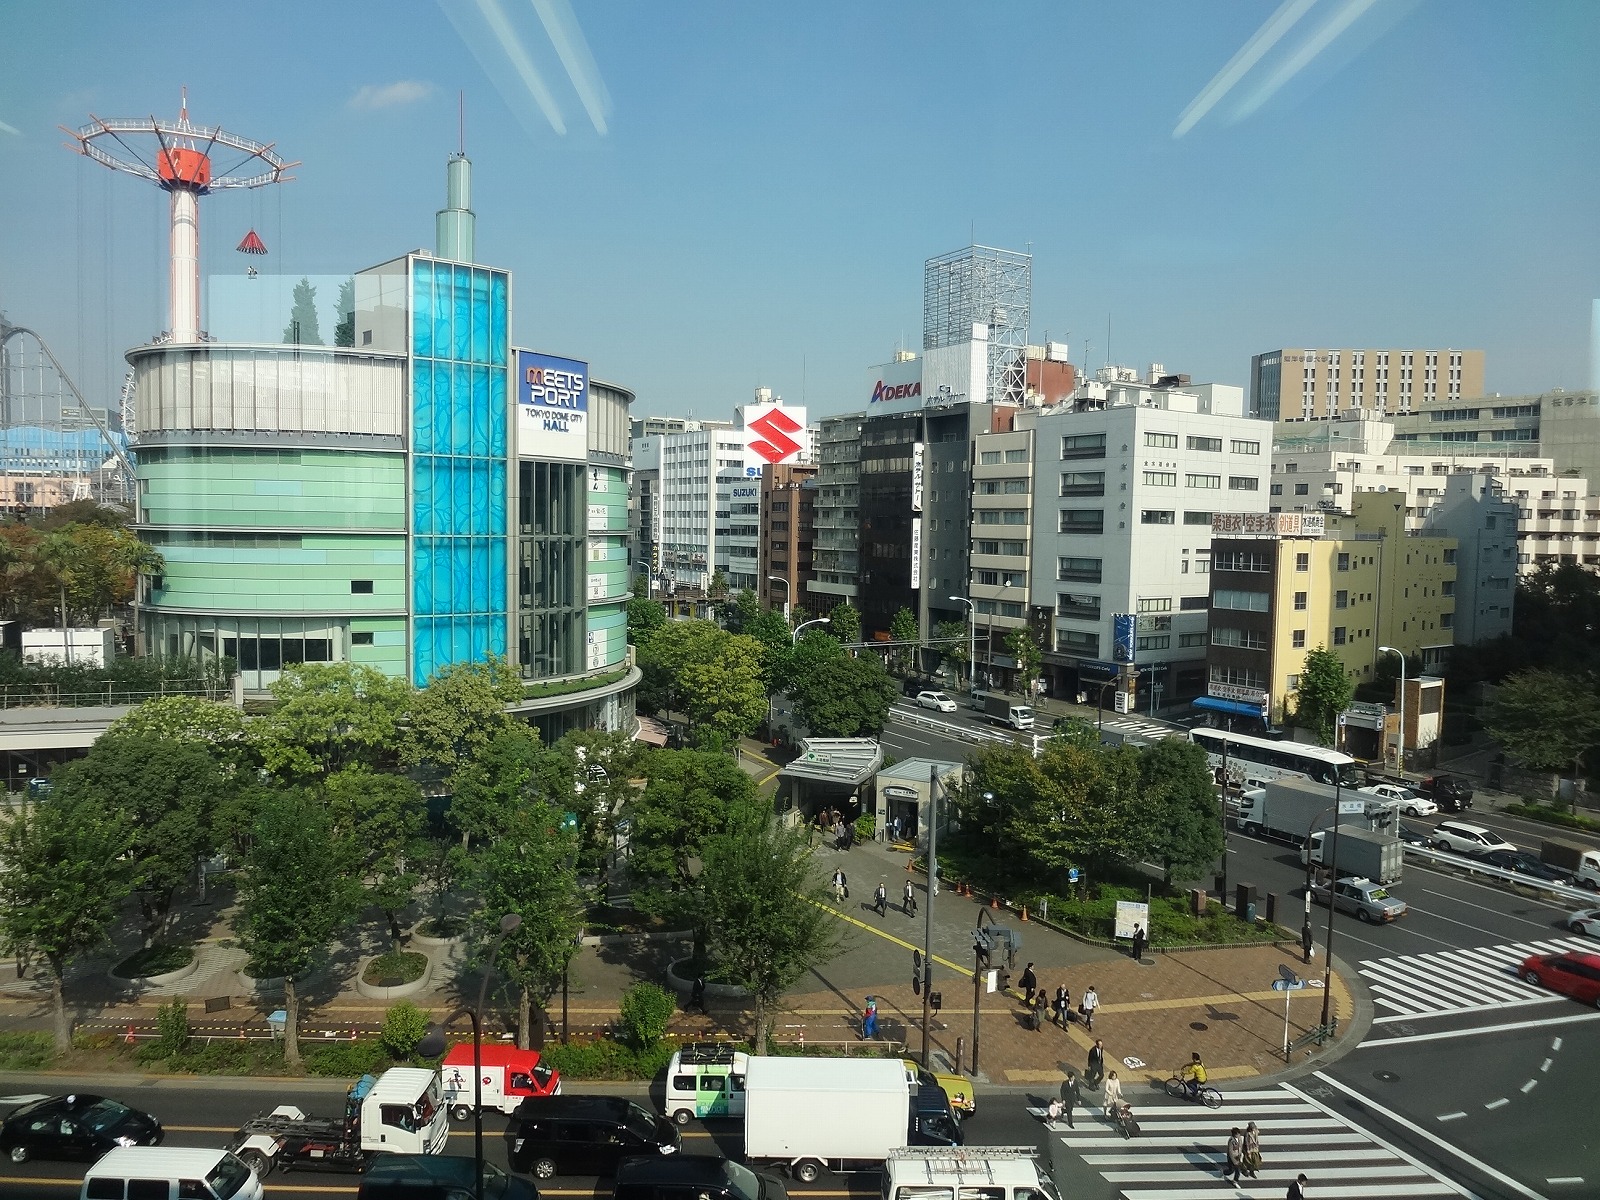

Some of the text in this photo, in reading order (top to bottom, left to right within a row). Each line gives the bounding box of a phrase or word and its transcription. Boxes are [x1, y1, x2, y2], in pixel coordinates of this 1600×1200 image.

[526, 367, 584, 391] MEETS
[531, 385, 581, 408] PORT
[871, 380, 922, 404] ADEKA
[526, 408, 584, 424] TOKYO DOME CITY
[543, 419, 570, 432] HALL
[733, 488, 757, 497] SUZUKI
[1212, 513, 1276, 533] 柔道衣 空手衣
[1279, 514, 1300, 533] 剣道具
